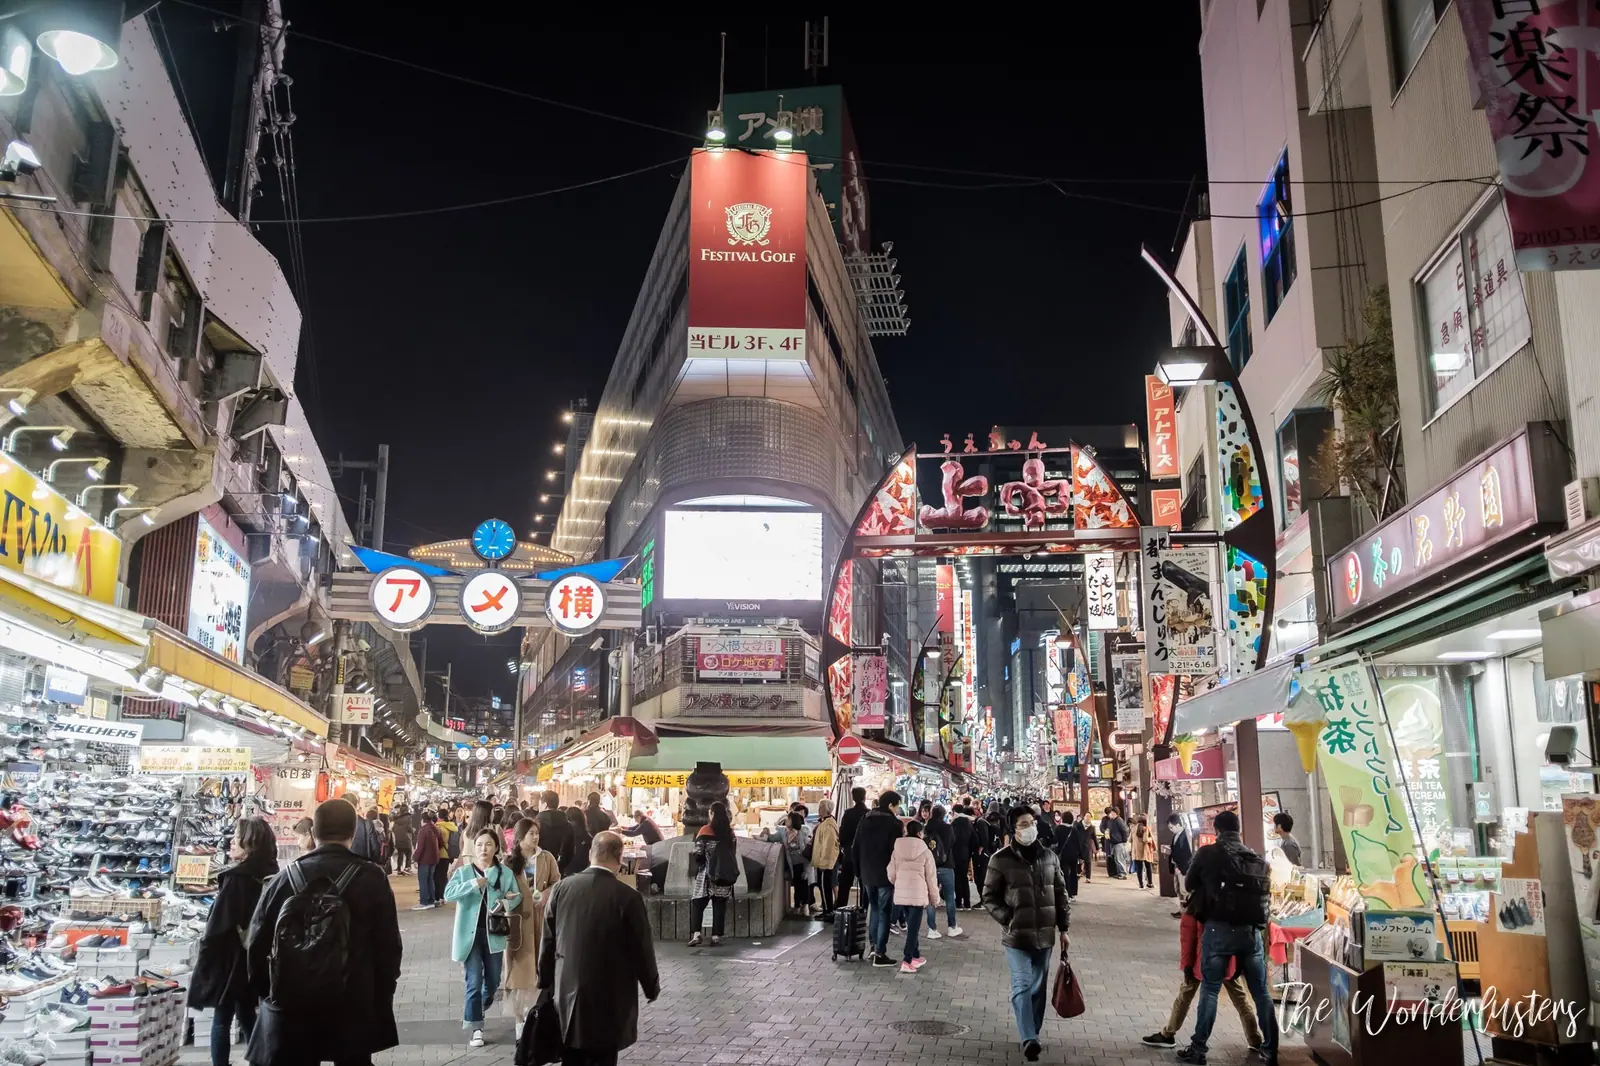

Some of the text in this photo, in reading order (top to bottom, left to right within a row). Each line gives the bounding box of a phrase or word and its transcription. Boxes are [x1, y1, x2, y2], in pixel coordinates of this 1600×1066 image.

[1489, 0, 1590, 161] 楽祭
[701, 249, 796, 263] FESTIVAL GOLF
[690, 334, 740, 350] 当ビル
[386, 578, 594, 619] アメ横
[346, 696, 371, 704] ATM
[685, 693, 798, 710] アメ横センター
[52, 722, 139, 739] SKECHERS
[1425, 781, 1443, 790] TEA
[1381, 925, 1431, 934] ソフトクリーム
